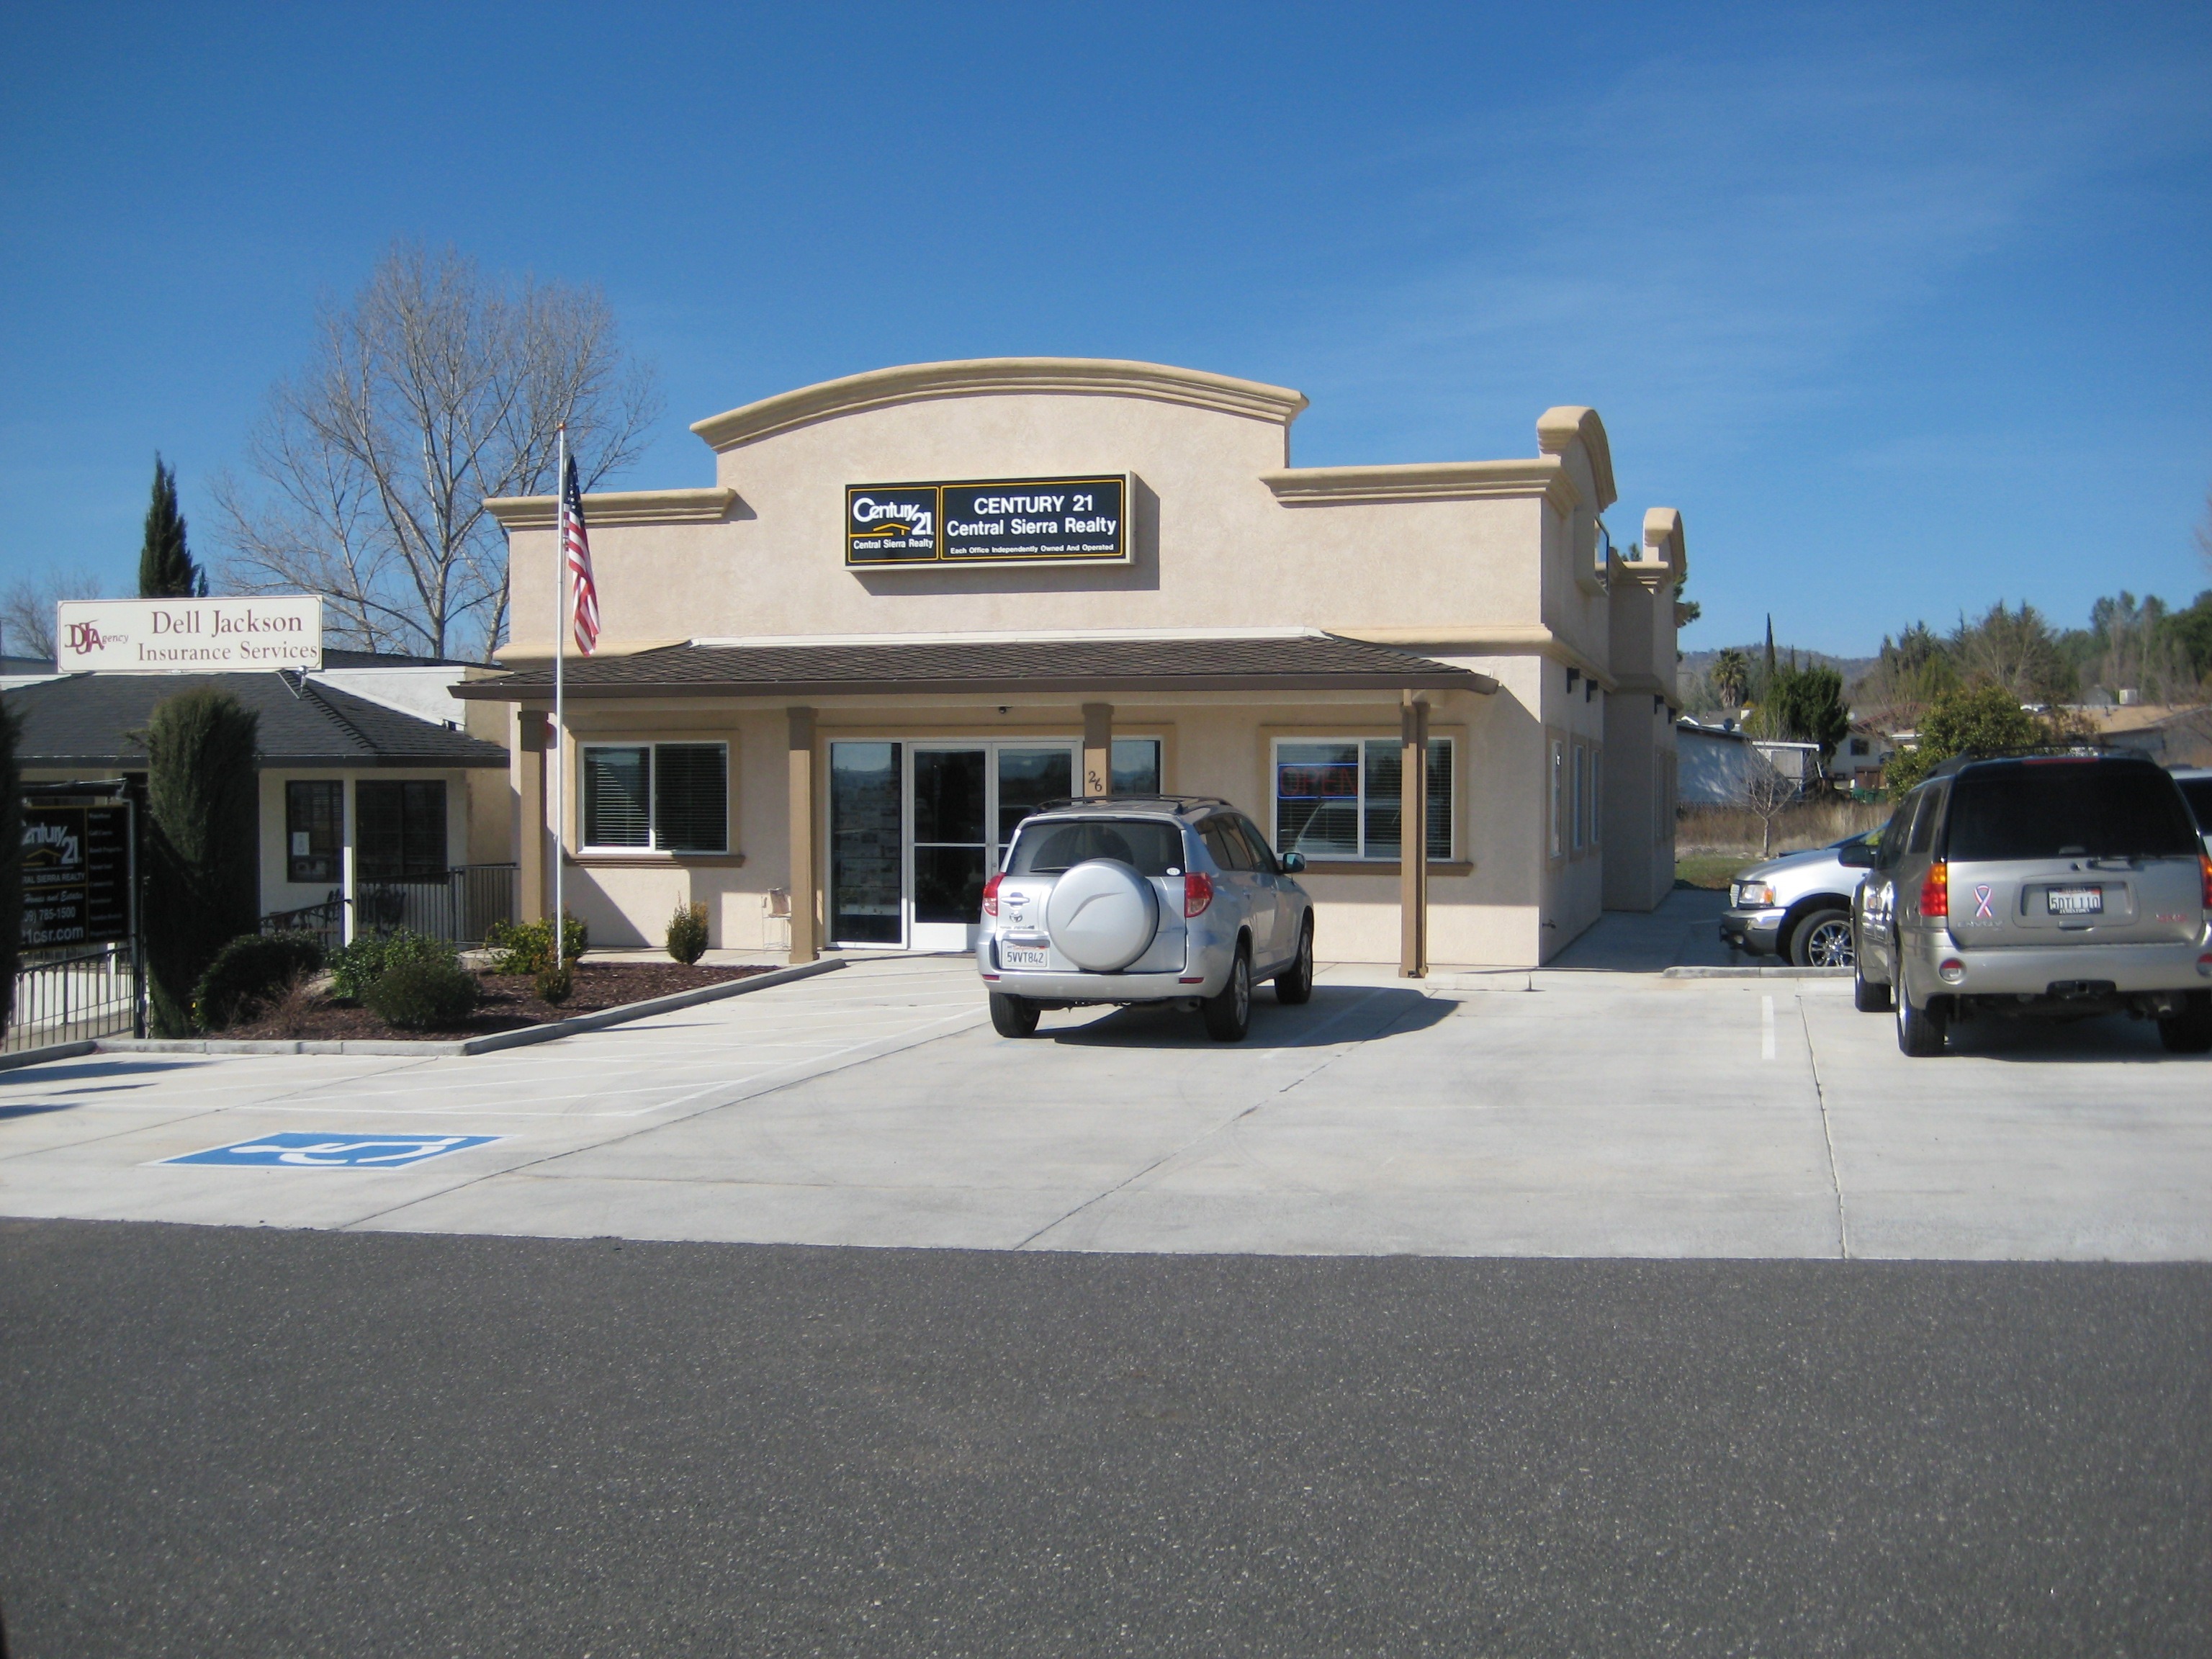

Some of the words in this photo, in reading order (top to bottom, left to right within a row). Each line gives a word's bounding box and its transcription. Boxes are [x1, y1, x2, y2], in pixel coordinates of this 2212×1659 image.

[853, 497, 920, 523] Century
[974, 495, 1065, 515] CENTURY
[1072, 494, 1094, 512] 21
[912, 512, 933, 536] 21
[947, 518, 1004, 538] Central
[1010, 518, 1058, 535] Sierra
[1065, 516, 1117, 536] Realty
[853, 539, 881, 549] Central
[883, 538, 906, 549] Sierra
[909, 538, 934, 549] Realty
[992, 545, 1038, 554] Independently
[1082, 543, 1114, 552] Operated
[151, 610, 201, 634] Dell
[211, 608, 303, 637] Jackson
[138, 643, 230, 661] Insurance
[240, 641, 318, 660] Services
[1088, 770, 1102, 792] 26
[1281, 766, 1357, 795] OPEN
[60, 835, 79, 865] 21
[1007, 951, 1044, 963] 5VVT842
